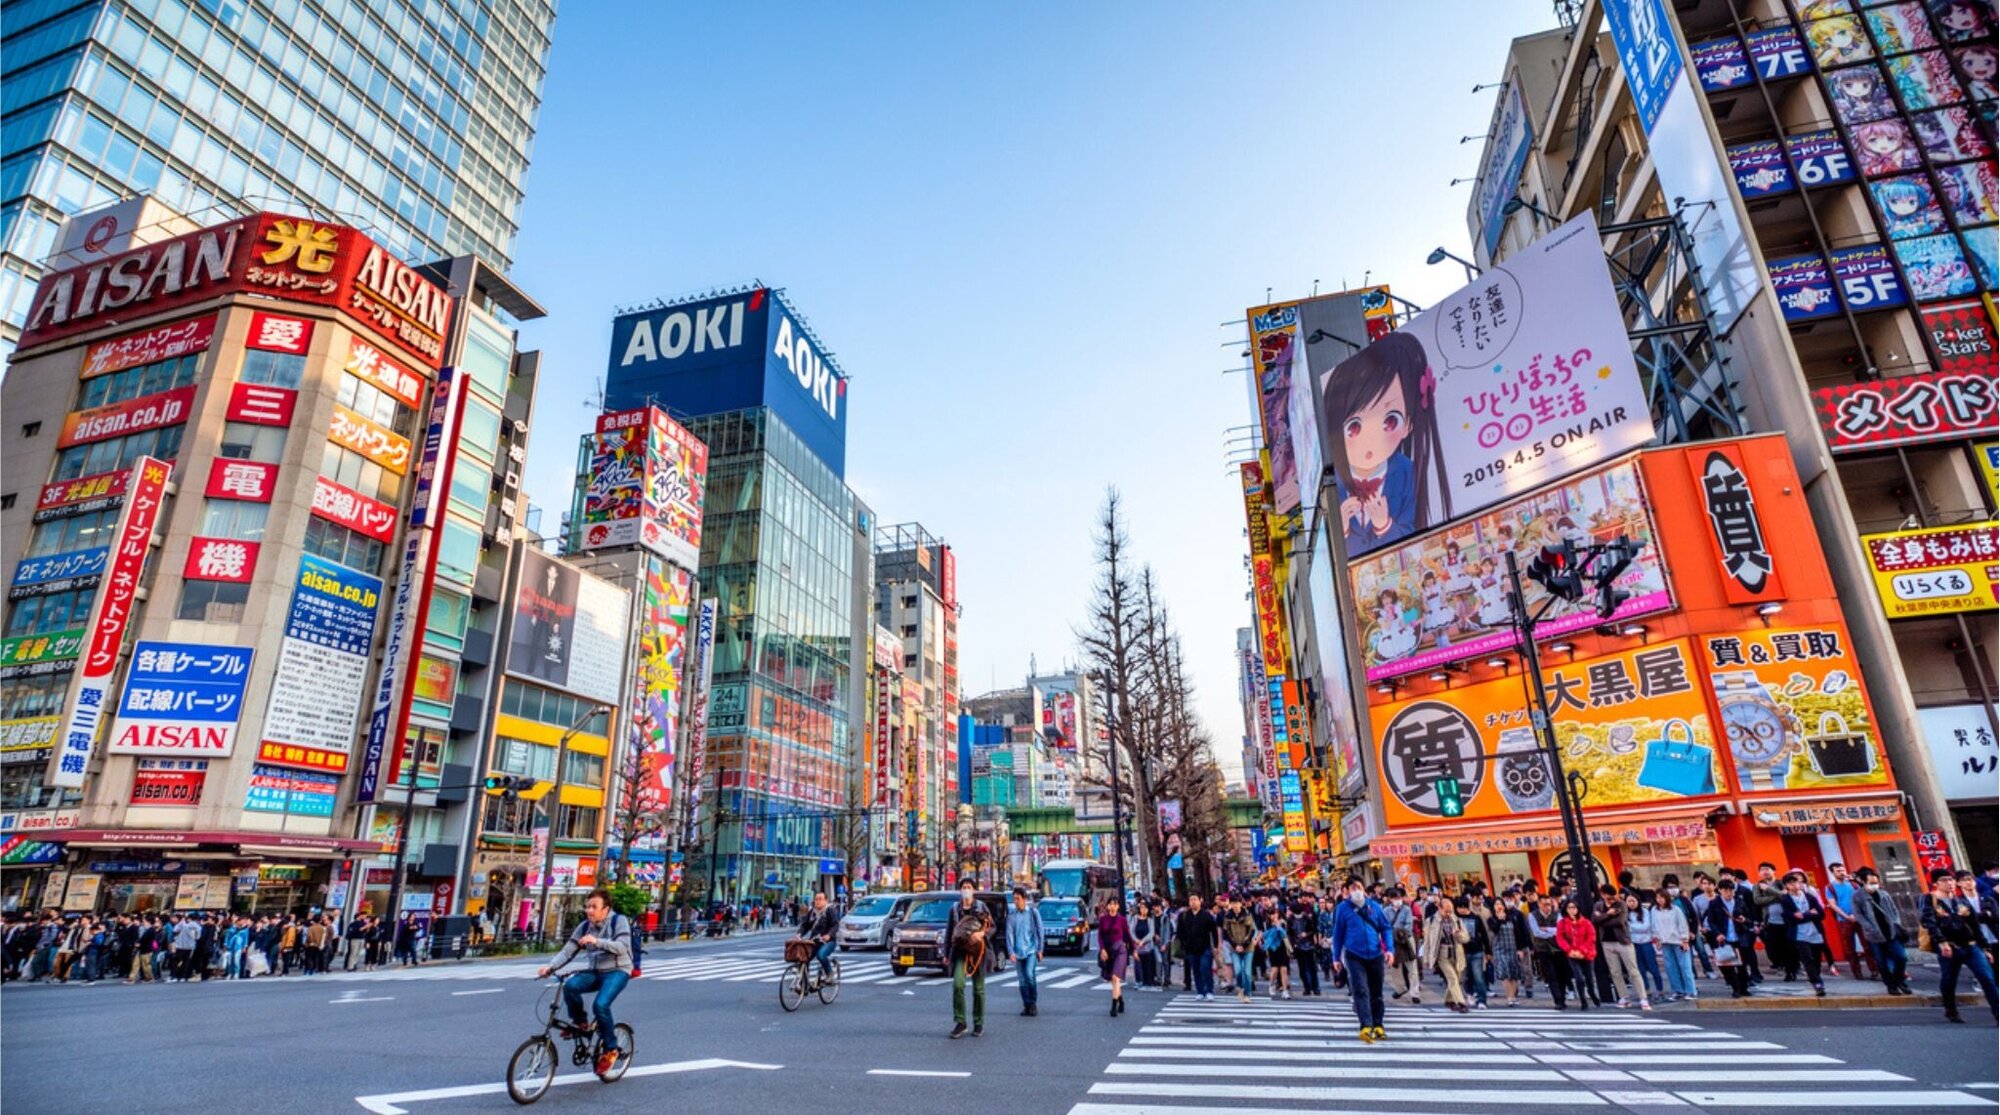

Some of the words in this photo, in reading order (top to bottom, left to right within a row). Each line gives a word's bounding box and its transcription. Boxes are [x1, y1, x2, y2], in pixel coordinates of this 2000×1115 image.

[1757, 49, 1805, 78] 7F
[1799, 153, 1849, 183] 6F
[262, 220, 337, 272] 光
[27, 224, 245, 331] AISAN
[247, 267, 338, 293] ネットワーク
[357, 244, 450, 336] AISAN
[1843, 272, 1897, 305] 5F
[1469, 297, 1491, 350] なりたい
[1485, 283, 1507, 328] 友達に
[258, 317, 304, 349] 愛
[621, 302, 745, 366] AOKI
[1940, 337, 1992, 357] Stars
[347, 344, 419, 402] 光通信
[774, 316, 838, 421] AOKI
[1463, 348, 1593, 418] ひとりぼっちの
[74, 399, 183, 441] aisan.co.jp
[240, 389, 285, 420] 三
[604, 411, 644, 430] 免税店
[330, 411, 409, 467] ネットワーク
[1464, 445, 1546, 487] 2019.4.5
[1551, 427, 1584, 448] ON
[1589, 406, 1628, 435] AIR
[43, 486, 65, 504] 3F
[222, 464, 265, 497] 電
[313, 485, 394, 532] 配線パーツ
[1701, 469, 1772, 578] 質
[18, 562, 38, 581] 2F
[40, 551, 108, 578] ネットワーク
[91, 465, 164, 667] 光・ケーブル・ネットワーク
[198, 542, 247, 577] 機
[1880, 536, 1999, 566] 全身もみほ
[302, 570, 377, 608] aisan.co.jp
[1899, 576, 1965, 593] りらくる
[1896, 595, 1985, 613] 秋葉原中央通り店
[701, 604, 714, 647] AKKY
[137, 649, 246, 676] 各種ケーブル
[1711, 637, 1745, 666] 質
[1750, 643, 1769, 664] &
[1771, 631, 1843, 661] 買取
[1541, 646, 1692, 714] 大黒屋
[127, 688, 237, 713] 配線パーツ
[1485, 709, 1528, 728] チケッ
[60, 687, 103, 774] 愛三電機
[116, 724, 229, 749] AISAN
[1259, 700, 1272, 748] Tax-free
[362, 712, 387, 793] AISAN
[1265, 749, 1276, 779] Shop
[1393, 713, 1477, 803] 質
[776, 813, 810, 847] AOKI
